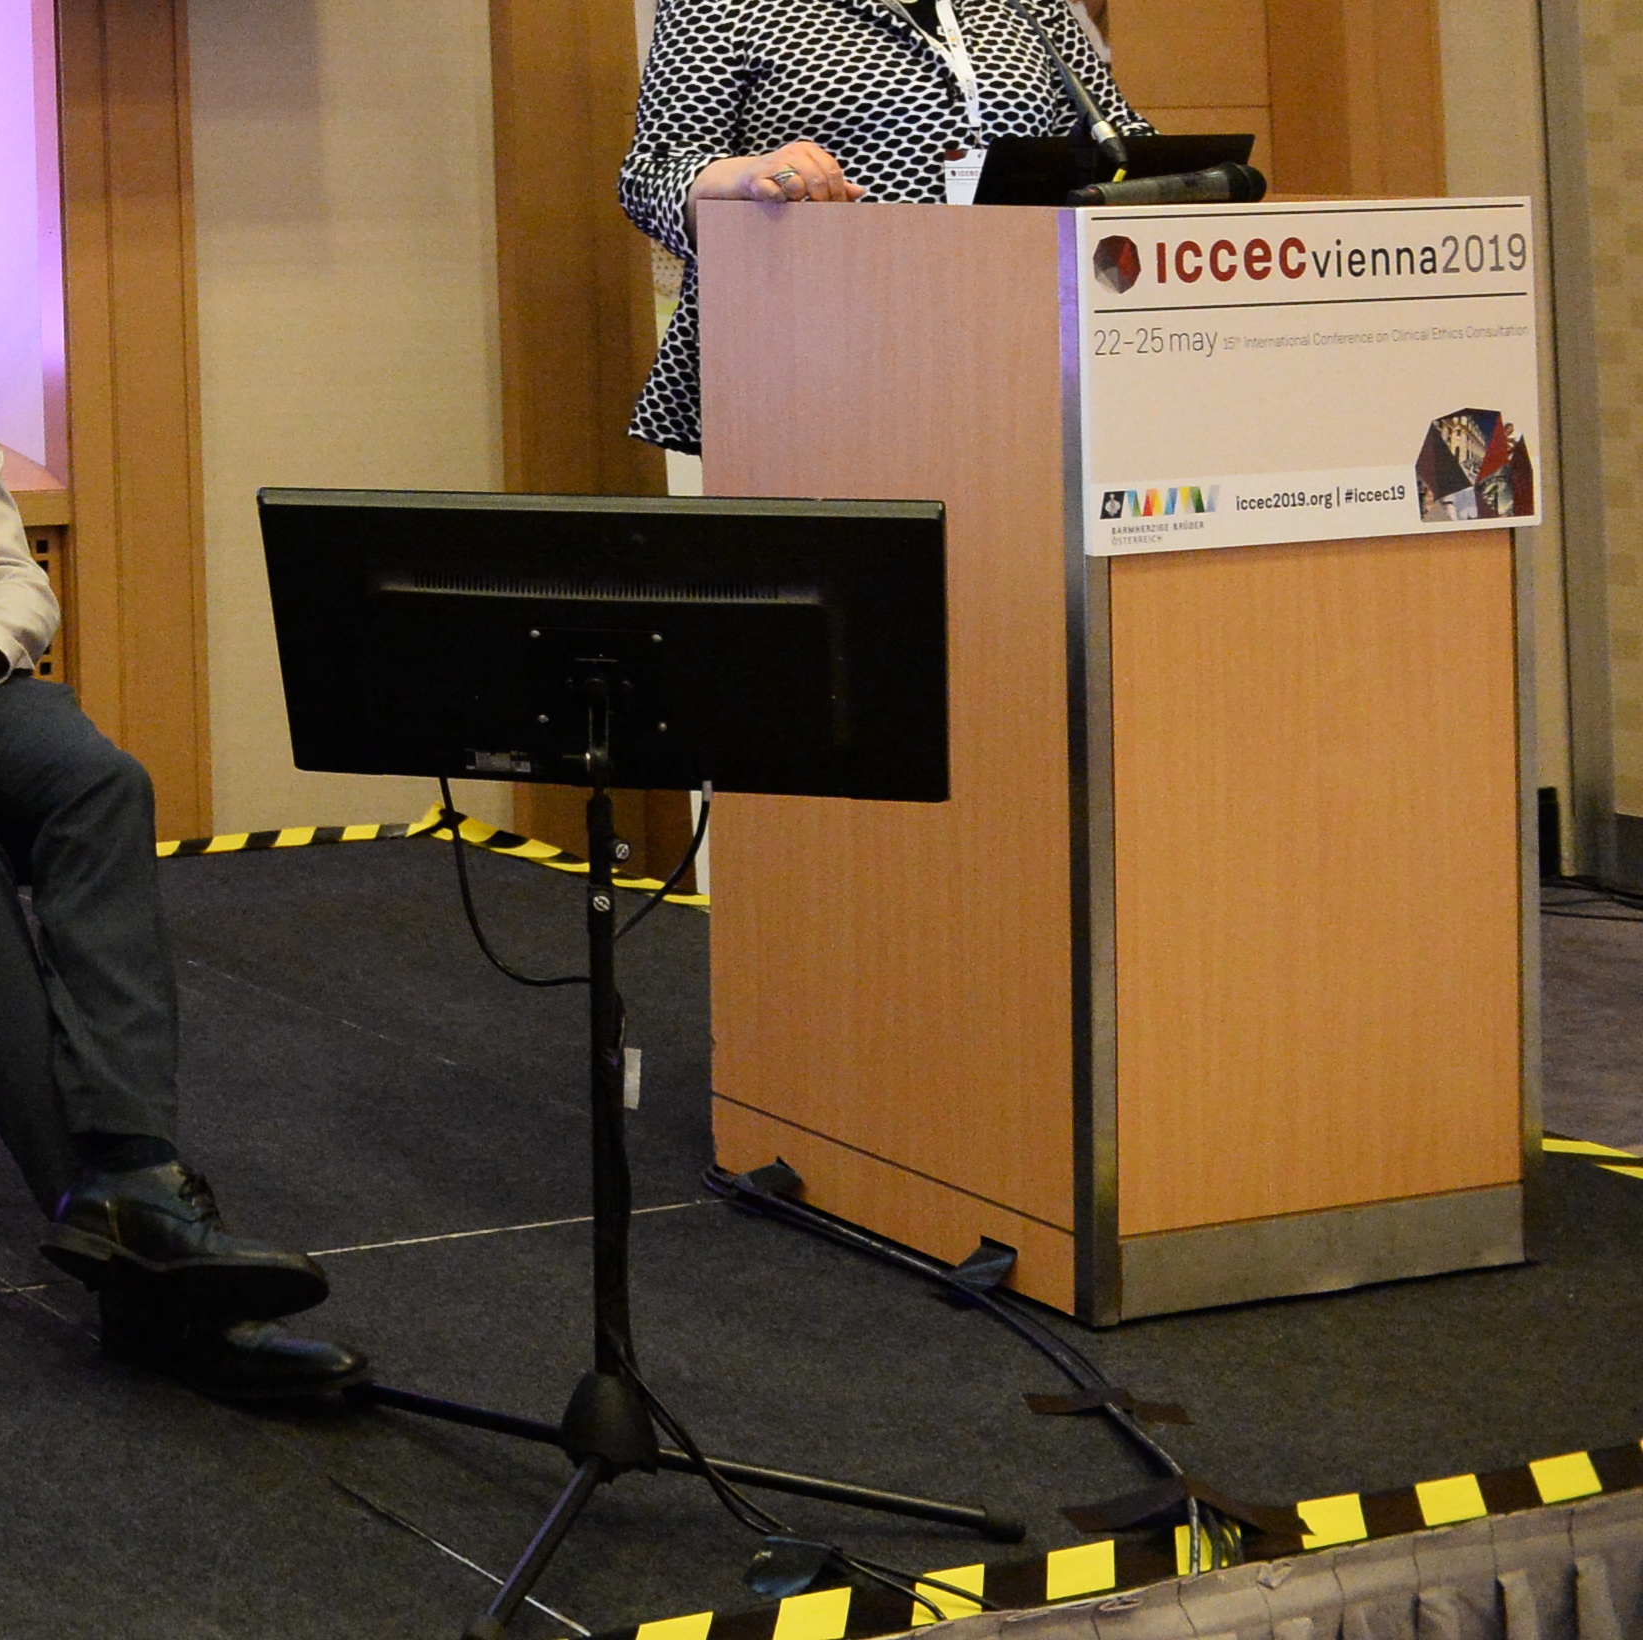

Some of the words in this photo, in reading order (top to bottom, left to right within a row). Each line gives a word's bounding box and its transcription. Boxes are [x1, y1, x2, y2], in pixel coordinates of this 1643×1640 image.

[1169, 331, 1218, 358] may
[1244, 334, 1311, 349] International
[1313, 331, 1373, 346] Conference
[1376, 333, 1389, 343] on
[1391, 328, 1430, 343] Clinical
[1431, 326, 1464, 341] Ethics
[1465, 324, 1530, 340] Consultation
[1235, 490, 1334, 512] iccec2019.org
[1344, 484, 1406, 504] #iccec19
[1110, 523, 1170, 535] BARMHERZIGE
[1172, 519, 1205, 531] BRÜDER
